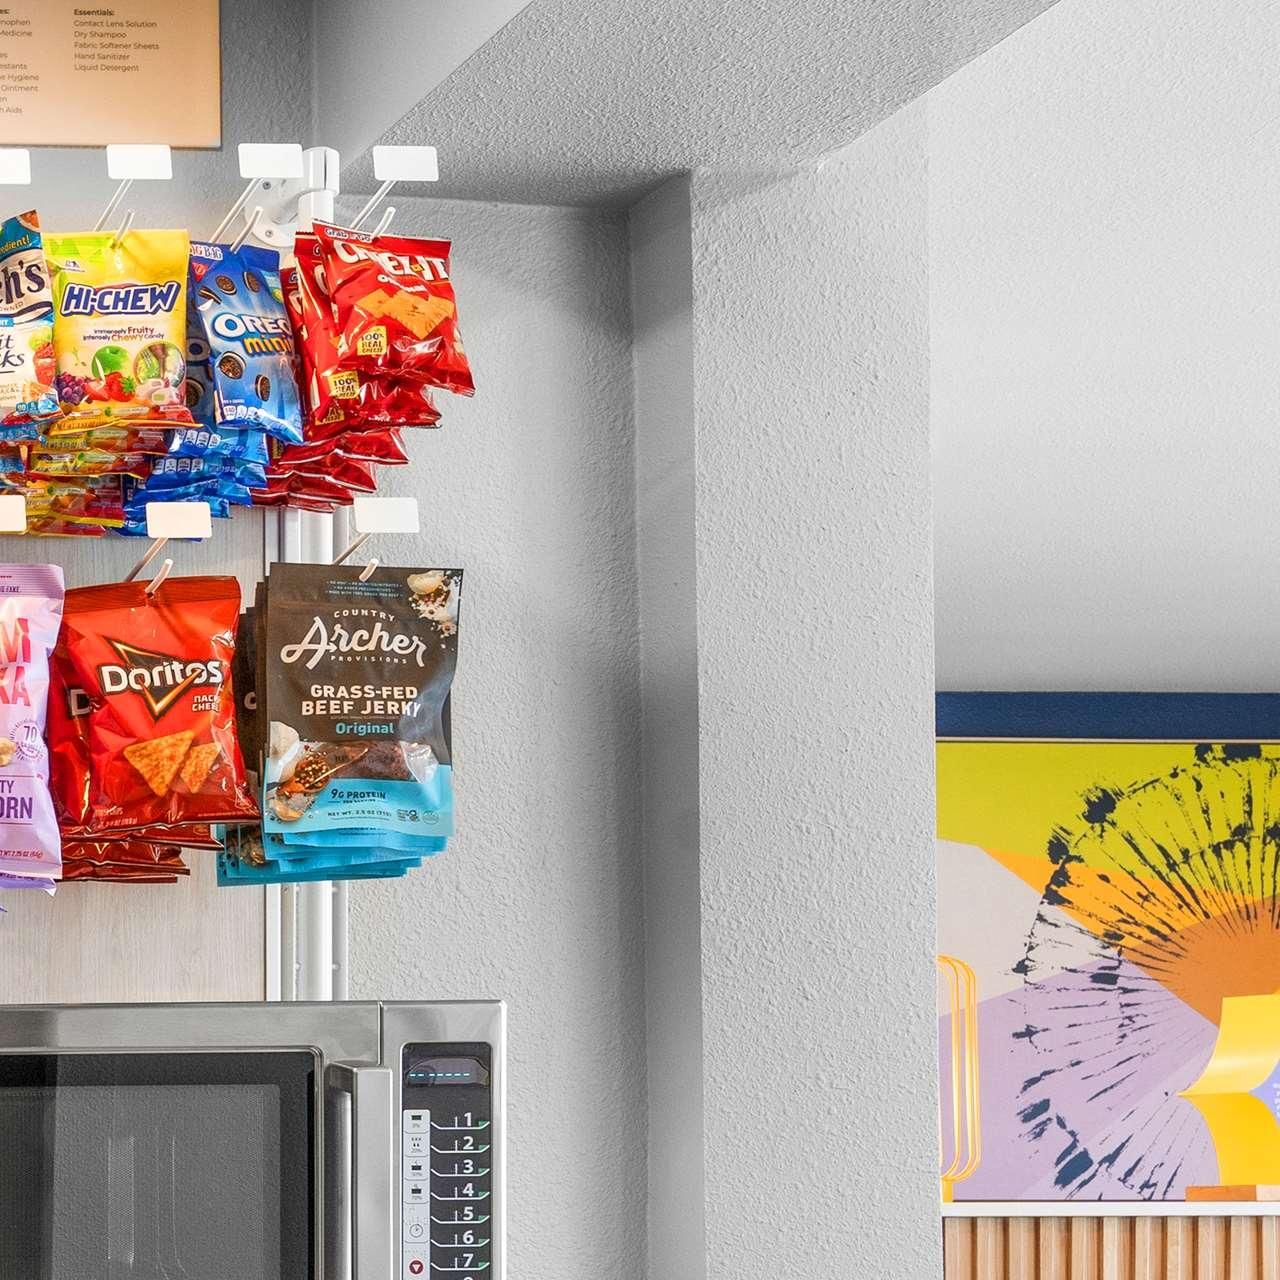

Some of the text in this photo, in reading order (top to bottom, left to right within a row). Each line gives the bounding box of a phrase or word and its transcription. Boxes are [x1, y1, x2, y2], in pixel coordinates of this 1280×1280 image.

[74, 8, 114, 16] Essentials:
[74, 31, 127, 39] Dry Shampoo
[98, 53, 130, 61] Sanitizer
[74, 64, 139, 72] Liquid Detergent
[8, 74, 39, 82] Hygiene
[61, 282, 179, 315] HI-CHEW
[333, 609, 396, 621] COUNTRY
[281, 616, 428, 669] Archer
[330, 654, 408, 664] PROVISIONS
[102, 660, 224, 694] Doritos
[310, 684, 418, 700] GRASS-FED
[302, 699, 421, 718] BEEF JERKY
[335, 721, 395, 736] Original
[347, 791, 386, 800] PROTEIN
[464, 1113, 472, 1126] 1
[463, 1136, 474, 1150] 2
[463, 1160, 473, 1173] 3
[462, 1183, 474, 1197] 4
[463, 1207, 473, 1220] 5
[463, 1230, 474, 1244] 6
[463, 1254, 473, 1267] 7
